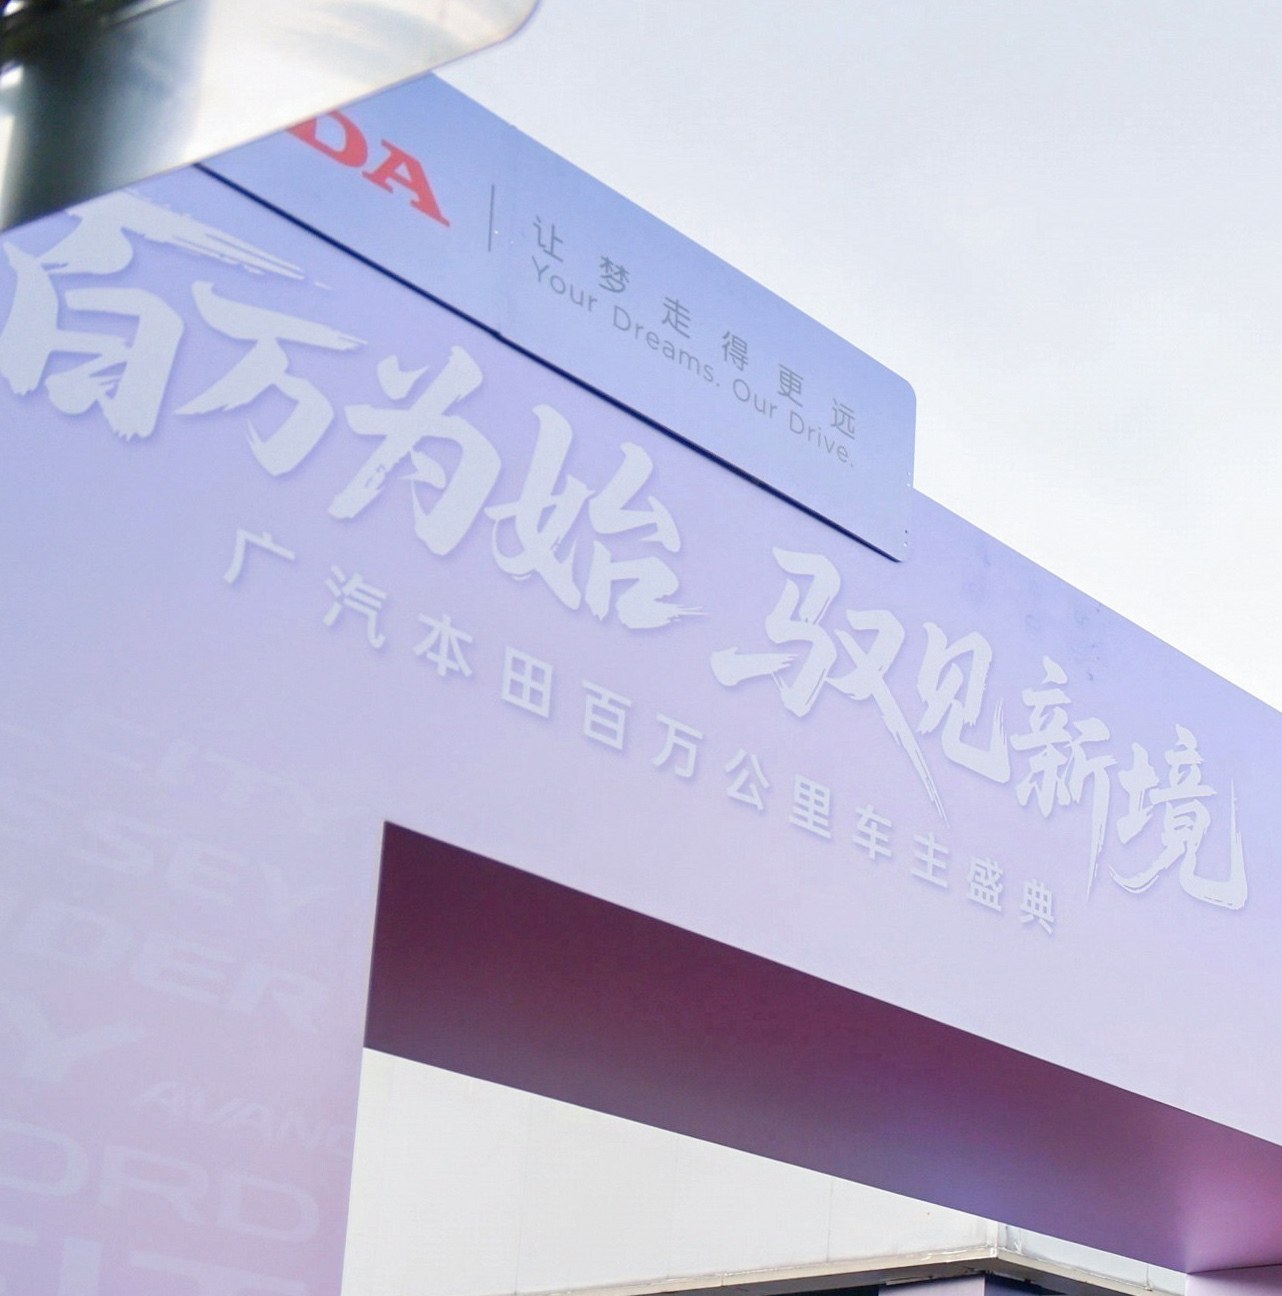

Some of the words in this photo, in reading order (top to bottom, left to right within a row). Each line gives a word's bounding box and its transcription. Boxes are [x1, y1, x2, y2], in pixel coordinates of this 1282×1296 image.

[530, 254, 600, 313] Your
[611, 304, 721, 389] Dreams.
[732, 378, 779, 420] Our
[788, 409, 856, 470] Drive.
[531, 213, 857, 441] 让梦走得更远
[2, 190, 706, 630] 百万为始
[711, 546, 1247, 910] 驭见新境
[222, 527, 1056, 934] 广汽本田百万公里车主盛典
